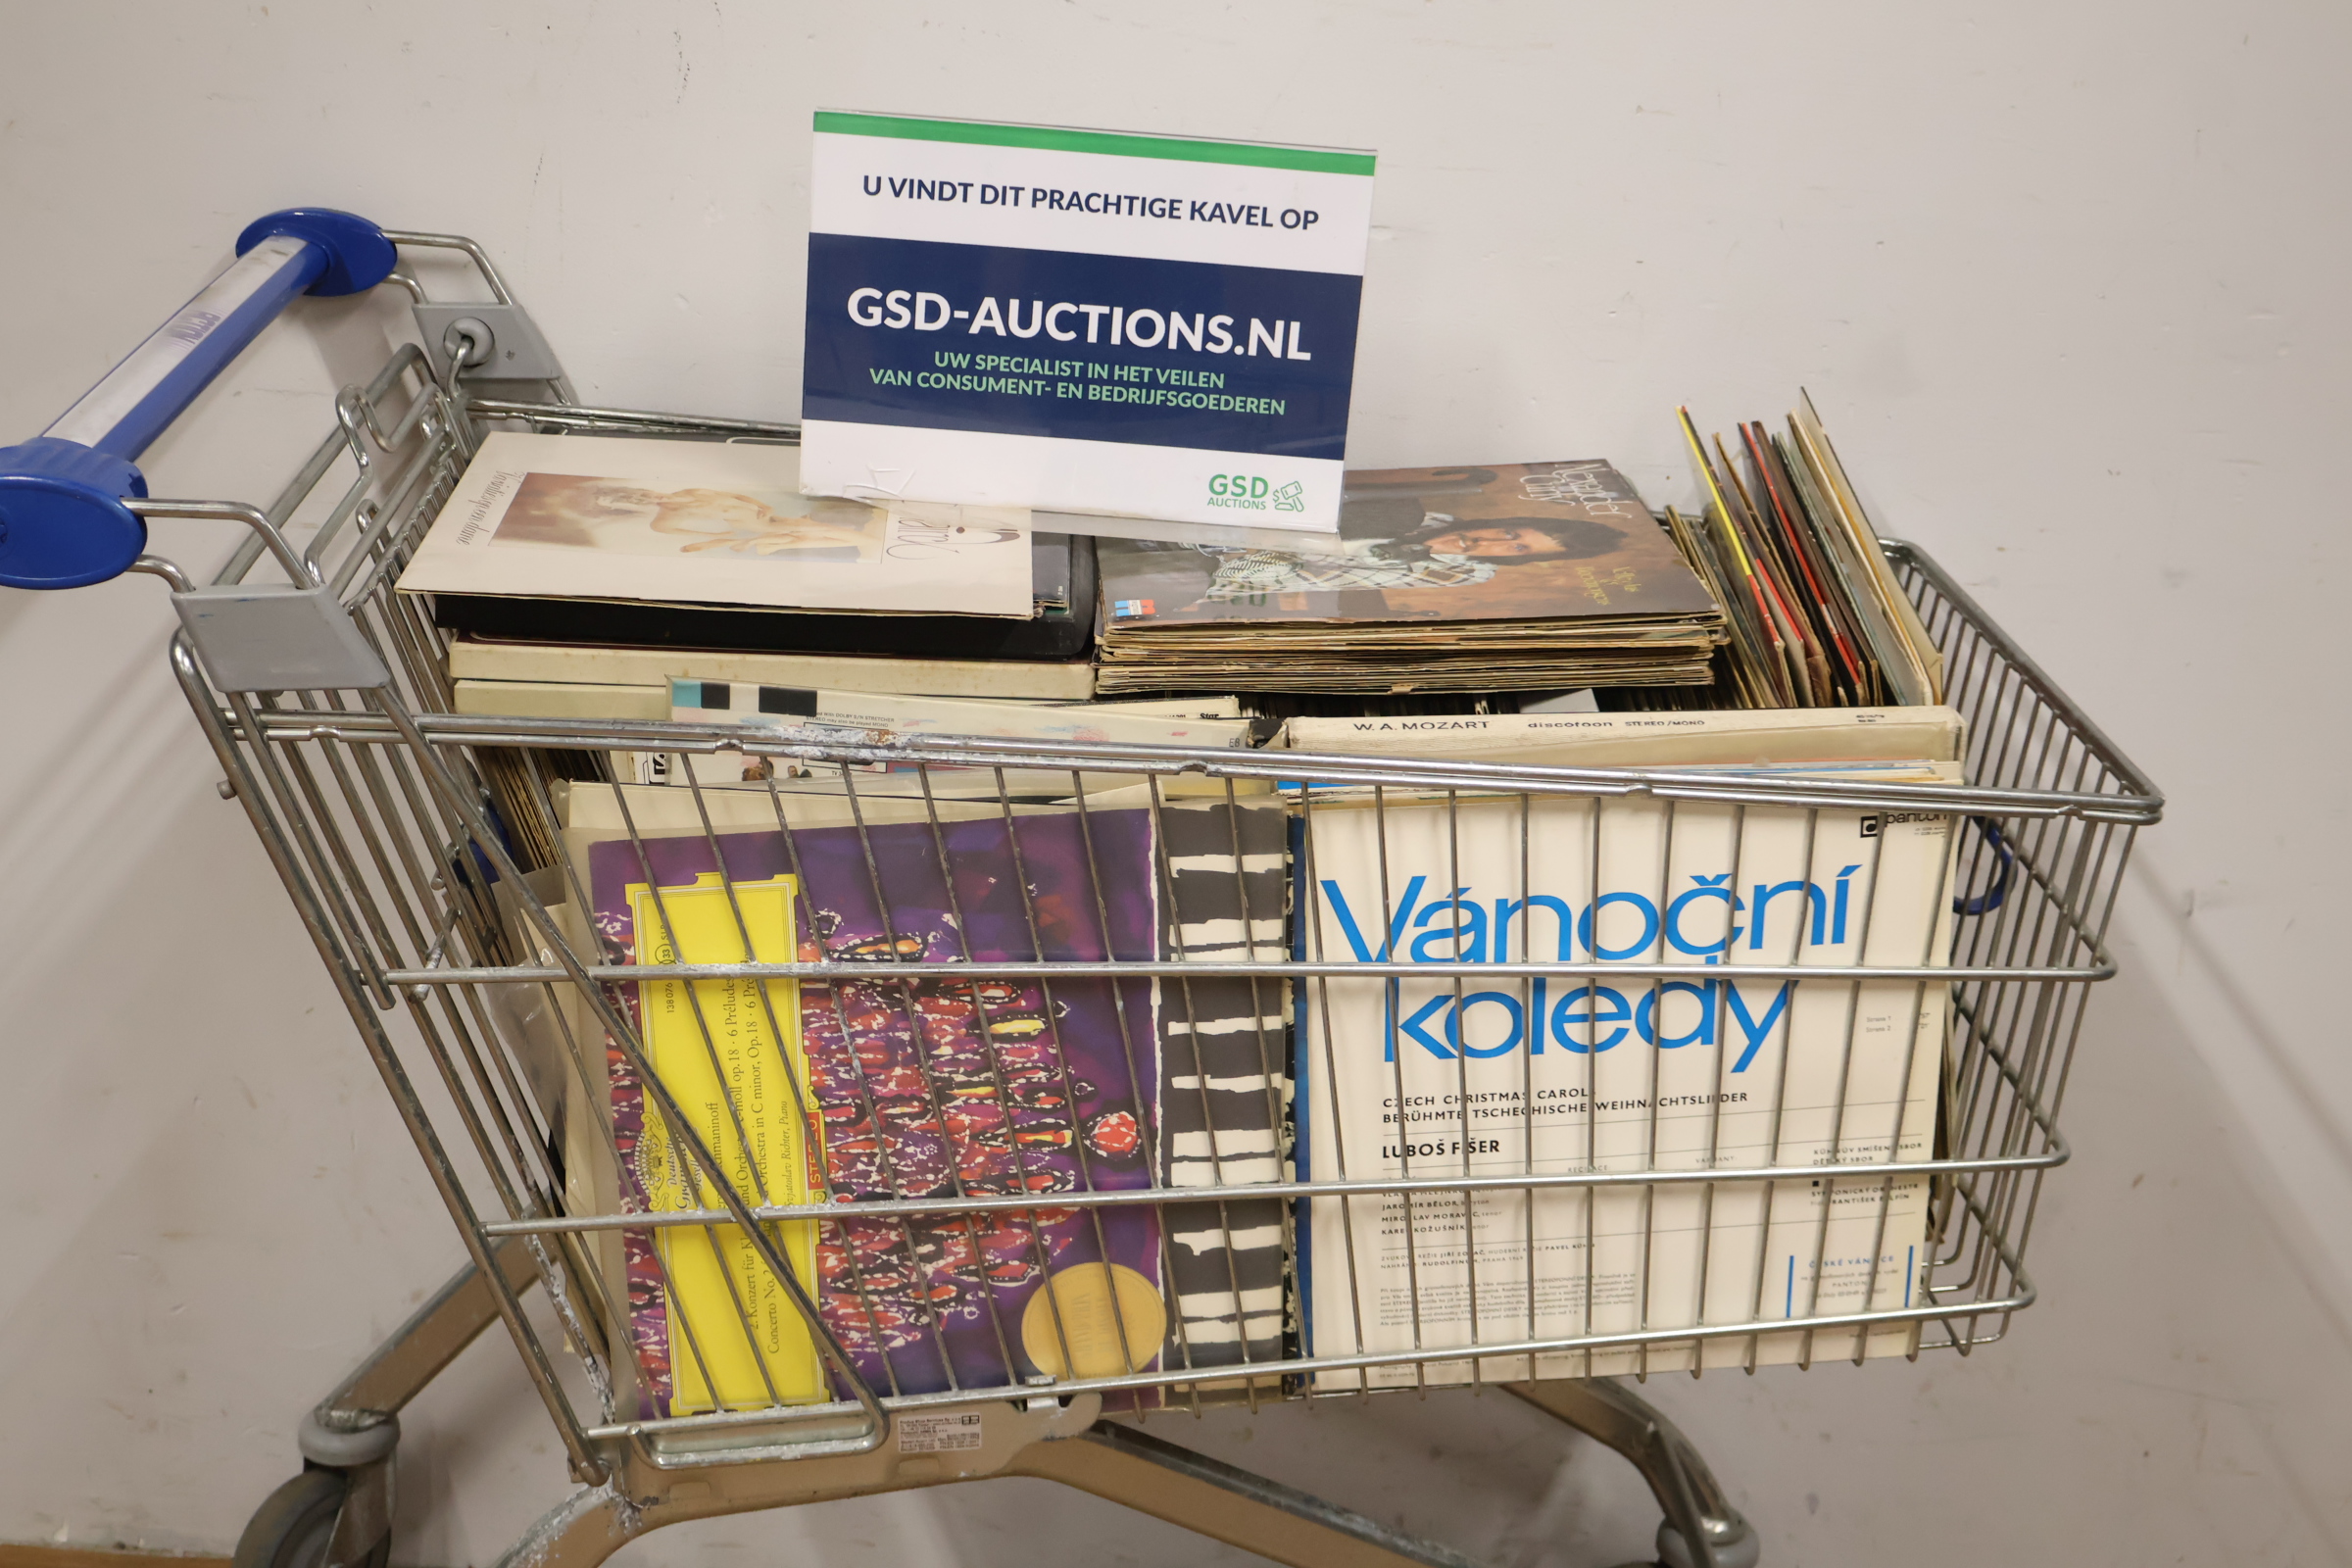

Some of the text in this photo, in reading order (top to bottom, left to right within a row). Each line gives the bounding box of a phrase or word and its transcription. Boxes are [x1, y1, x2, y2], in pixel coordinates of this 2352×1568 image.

[863, 175, 1319, 230] U VINDT DIT PRACHTIGE KAVEL OP
[847, 287, 1312, 361] GSD-AUCTIONS.NL
[934, 351, 1225, 389] UW SPECIALIST IN HET VEILEN
[869, 368, 1286, 416] VAN CONSUMENT- EN BEDRIJFSGOEDEREN
[1208, 473, 1269, 499] GSD
[1206, 497, 1266, 511] AUCTIONS
[1401, 720, 1490, 731] MOZART
[1320, 864, 1863, 963] Vánoční
[662, 949, 671, 959] 33
[1385, 956, 1800, 1073] koledy
[750, 1060, 763, 1100] minor,
[751, 1103, 763, 1114] C
[779, 1101, 789, 1127] Piano
[753, 1117, 765, 1129] in
[1383, 1139, 1445, 1158] LUBOŠ
[1382, 1214, 1430, 1223] MIROLAV
[742, 1253, 755, 1271] für
[1809, 1254, 1894, 1269] ČSKÉ VÁNCE
[747, 1275, 759, 1318] Konzert
[767, 1302, 780, 1354] Concerto
